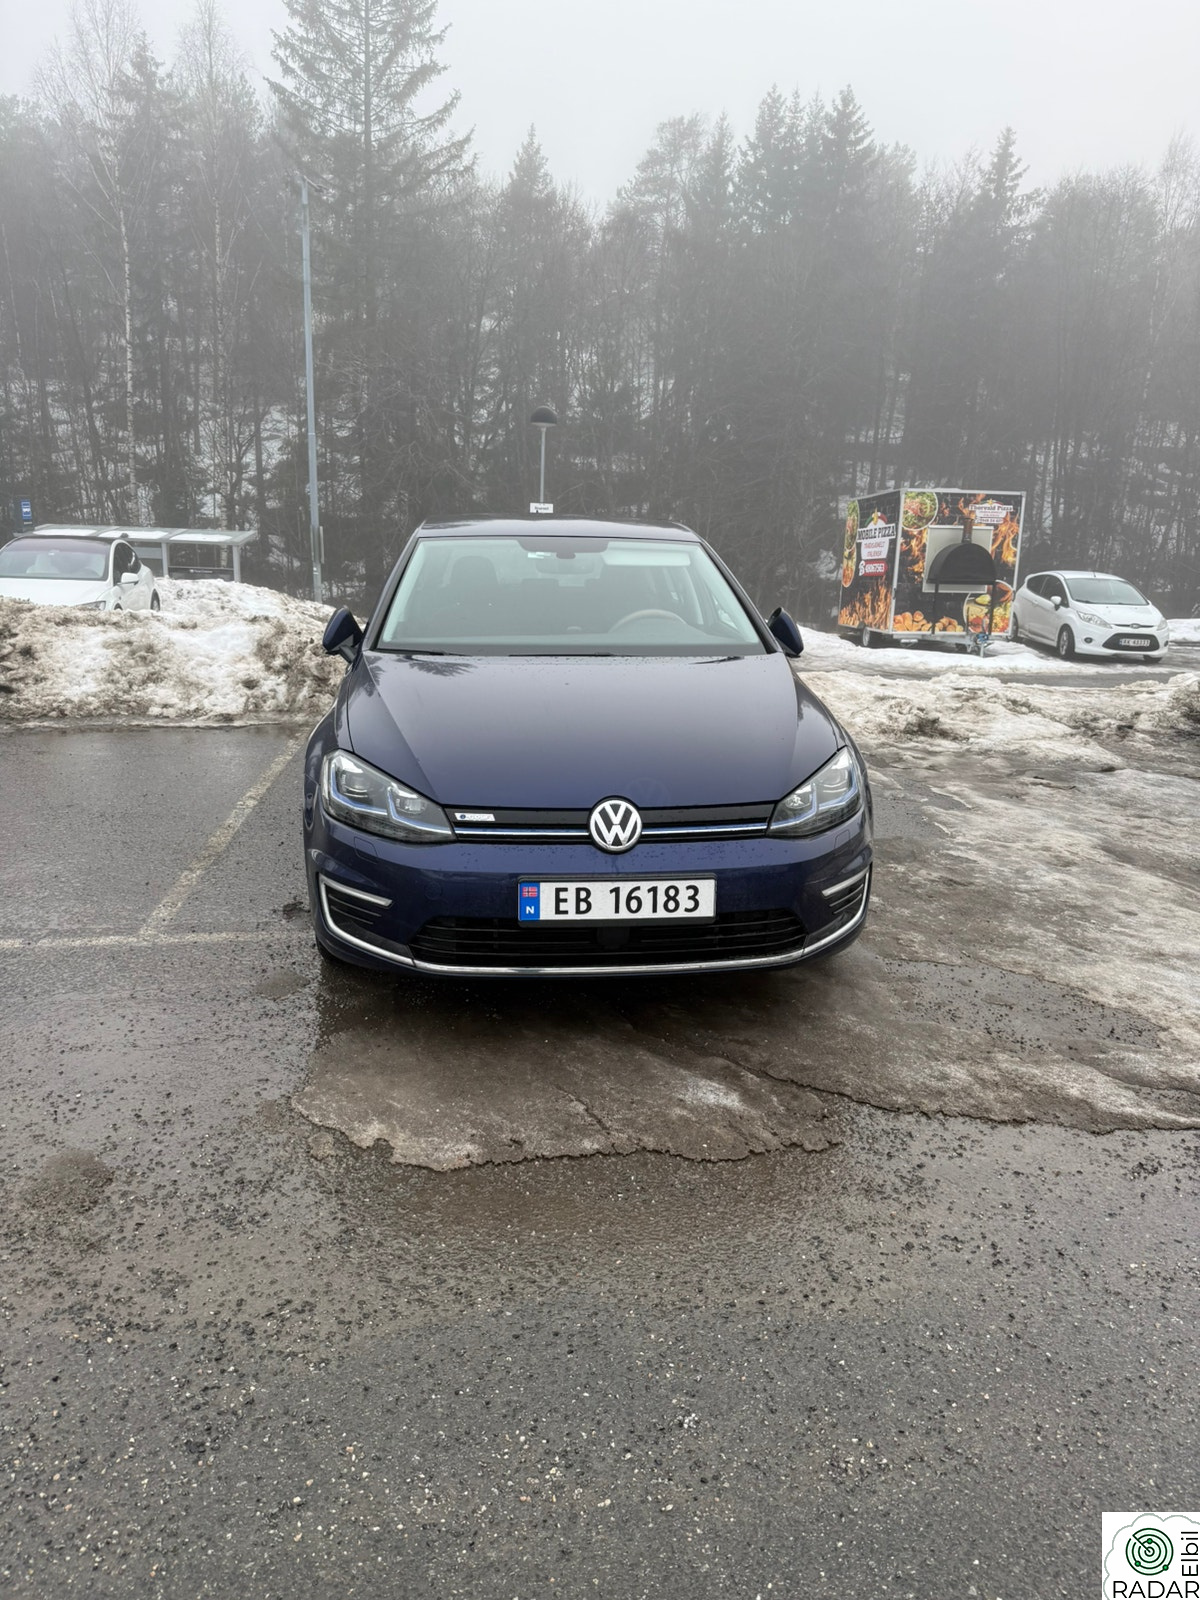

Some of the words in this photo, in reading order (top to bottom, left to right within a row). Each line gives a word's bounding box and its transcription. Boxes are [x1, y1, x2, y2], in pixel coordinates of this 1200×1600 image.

[857, 526, 877, 540] MOBILE
[878, 524, 896, 538] PIZZA
[554, 887, 592, 915] EB
[609, 885, 700, 915] 16183
[525, 905, 535, 915] N
